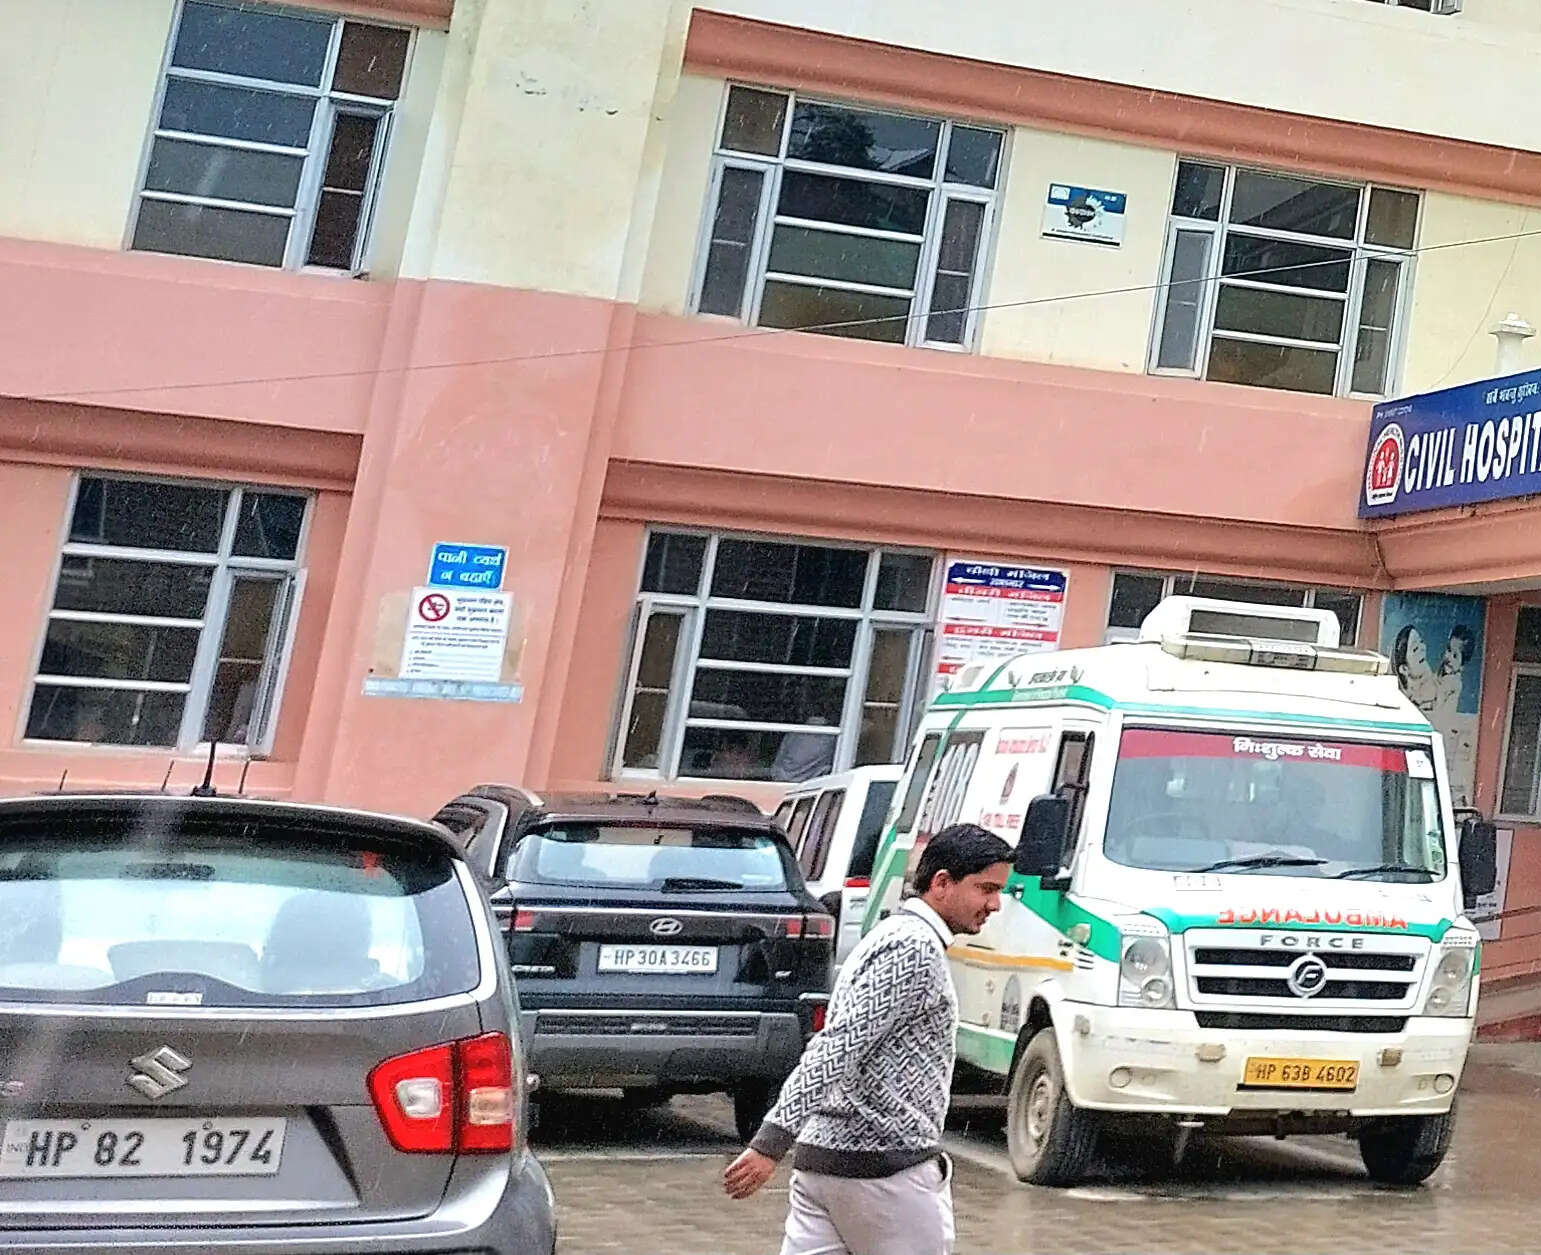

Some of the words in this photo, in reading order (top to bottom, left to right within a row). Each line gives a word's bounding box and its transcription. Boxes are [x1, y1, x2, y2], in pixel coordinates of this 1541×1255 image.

[1404, 427, 1456, 494] CIVIL
[1307, 743, 1341, 760] सेवा
[1260, 934, 1365, 949] FORCE
[1256, 1063, 1275, 1080] HP
[1316, 1066, 1355, 1083] 4602
[26, 1130, 78, 1166] HP
[94, 1131, 144, 1166] 82
[183, 1129, 275, 1165] 1974
